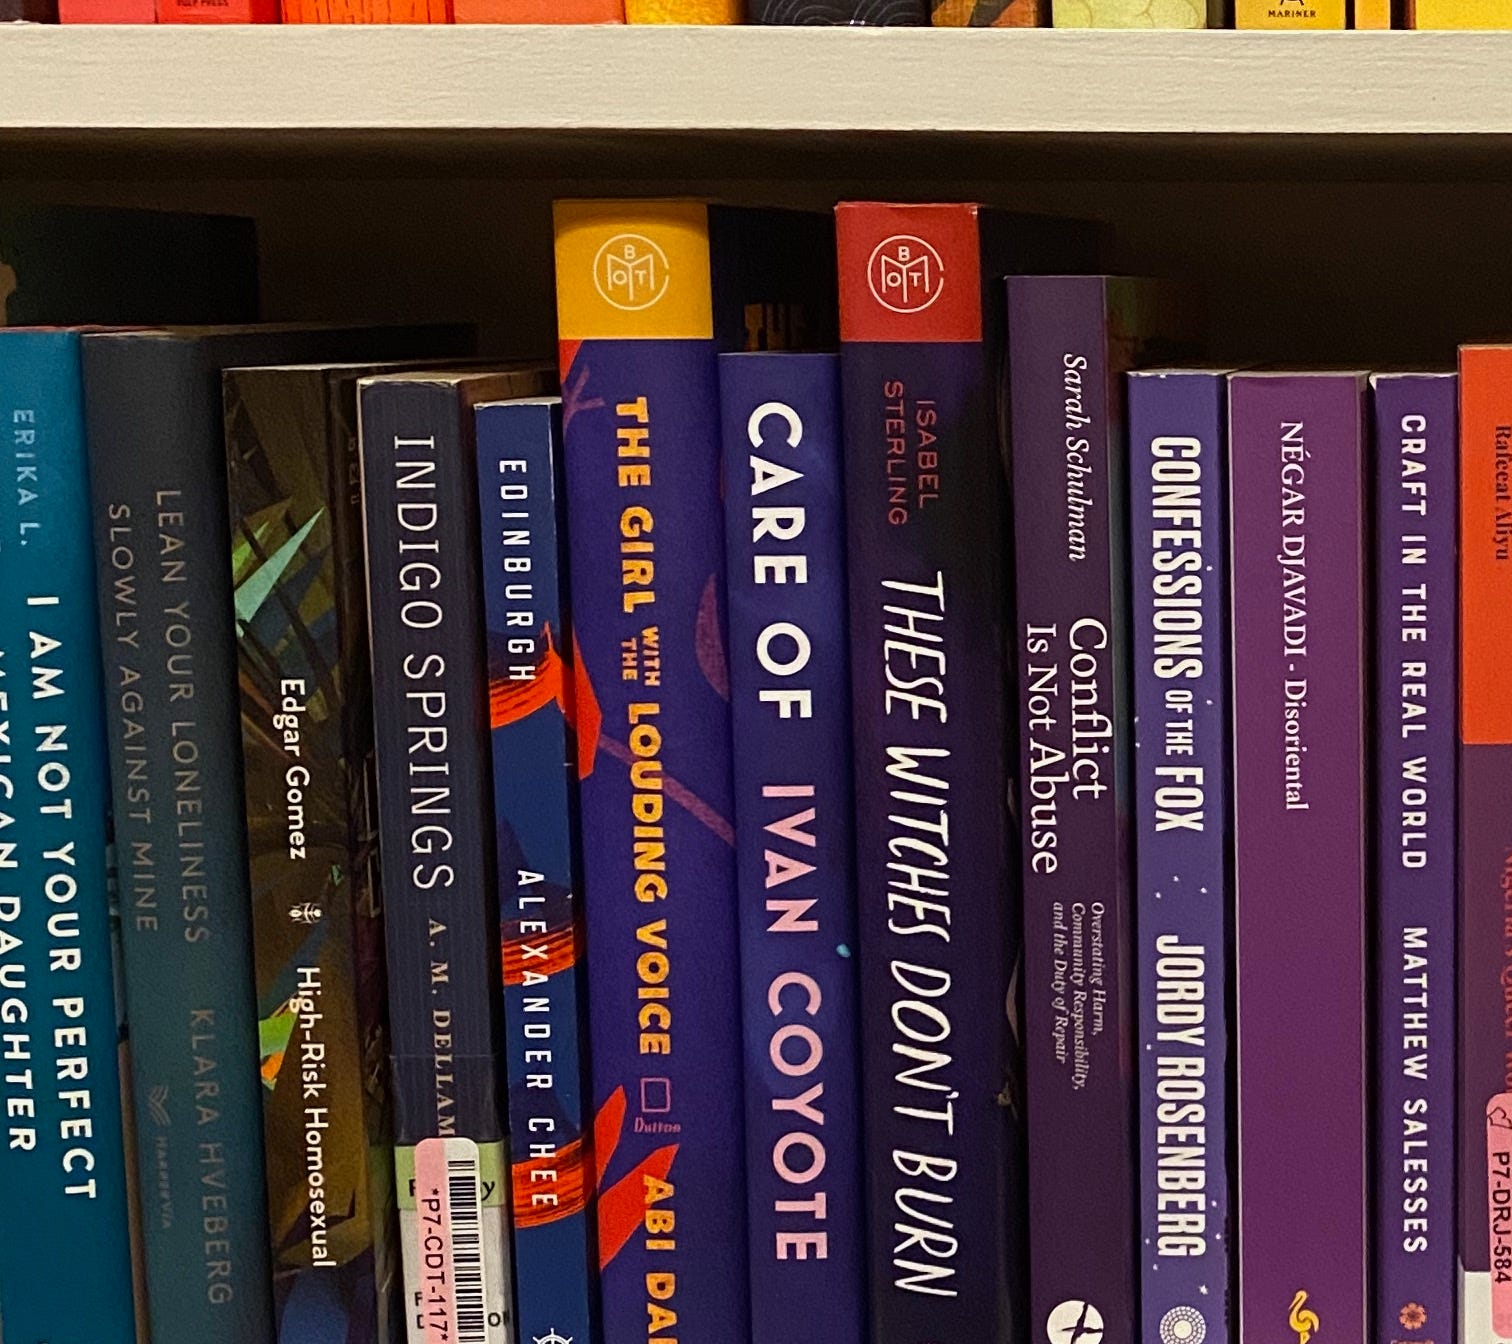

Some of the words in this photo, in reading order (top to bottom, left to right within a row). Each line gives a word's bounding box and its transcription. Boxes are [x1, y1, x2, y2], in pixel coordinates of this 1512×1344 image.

[1267, 9, 1316, 18] MARINER
[884, 381, 907, 526] STERLING
[915, 400, 941, 509] ISABEL
[499, 460, 536, 681] EDINBURGH
[272, 679, 307, 756] Edgar
[1069, 617, 1112, 800] Conflict
[282, 763, 311, 860] Gomez
[517, 870, 552, 1089] ALEXANDER
[1090, 902, 1106, 987] Overstating
[1155, 934, 1206, 1047] JORDY
[1403, 928, 1429, 1081] MATTHEW
[289, 967, 326, 1100] High-Risk
[1092, 991, 1106, 1036] Harm,
[302, 1108, 336, 1268] Homosexual
[529, 1119, 557, 1207] CHEE
[643, 1176, 676, 1250] ABI
[1155, 1055, 1207, 1257] ROSENBERG
[1403, 1099, 1427, 1254] SALESSES
[1492, 1152, 1511, 1283] P7-DRJ-584
